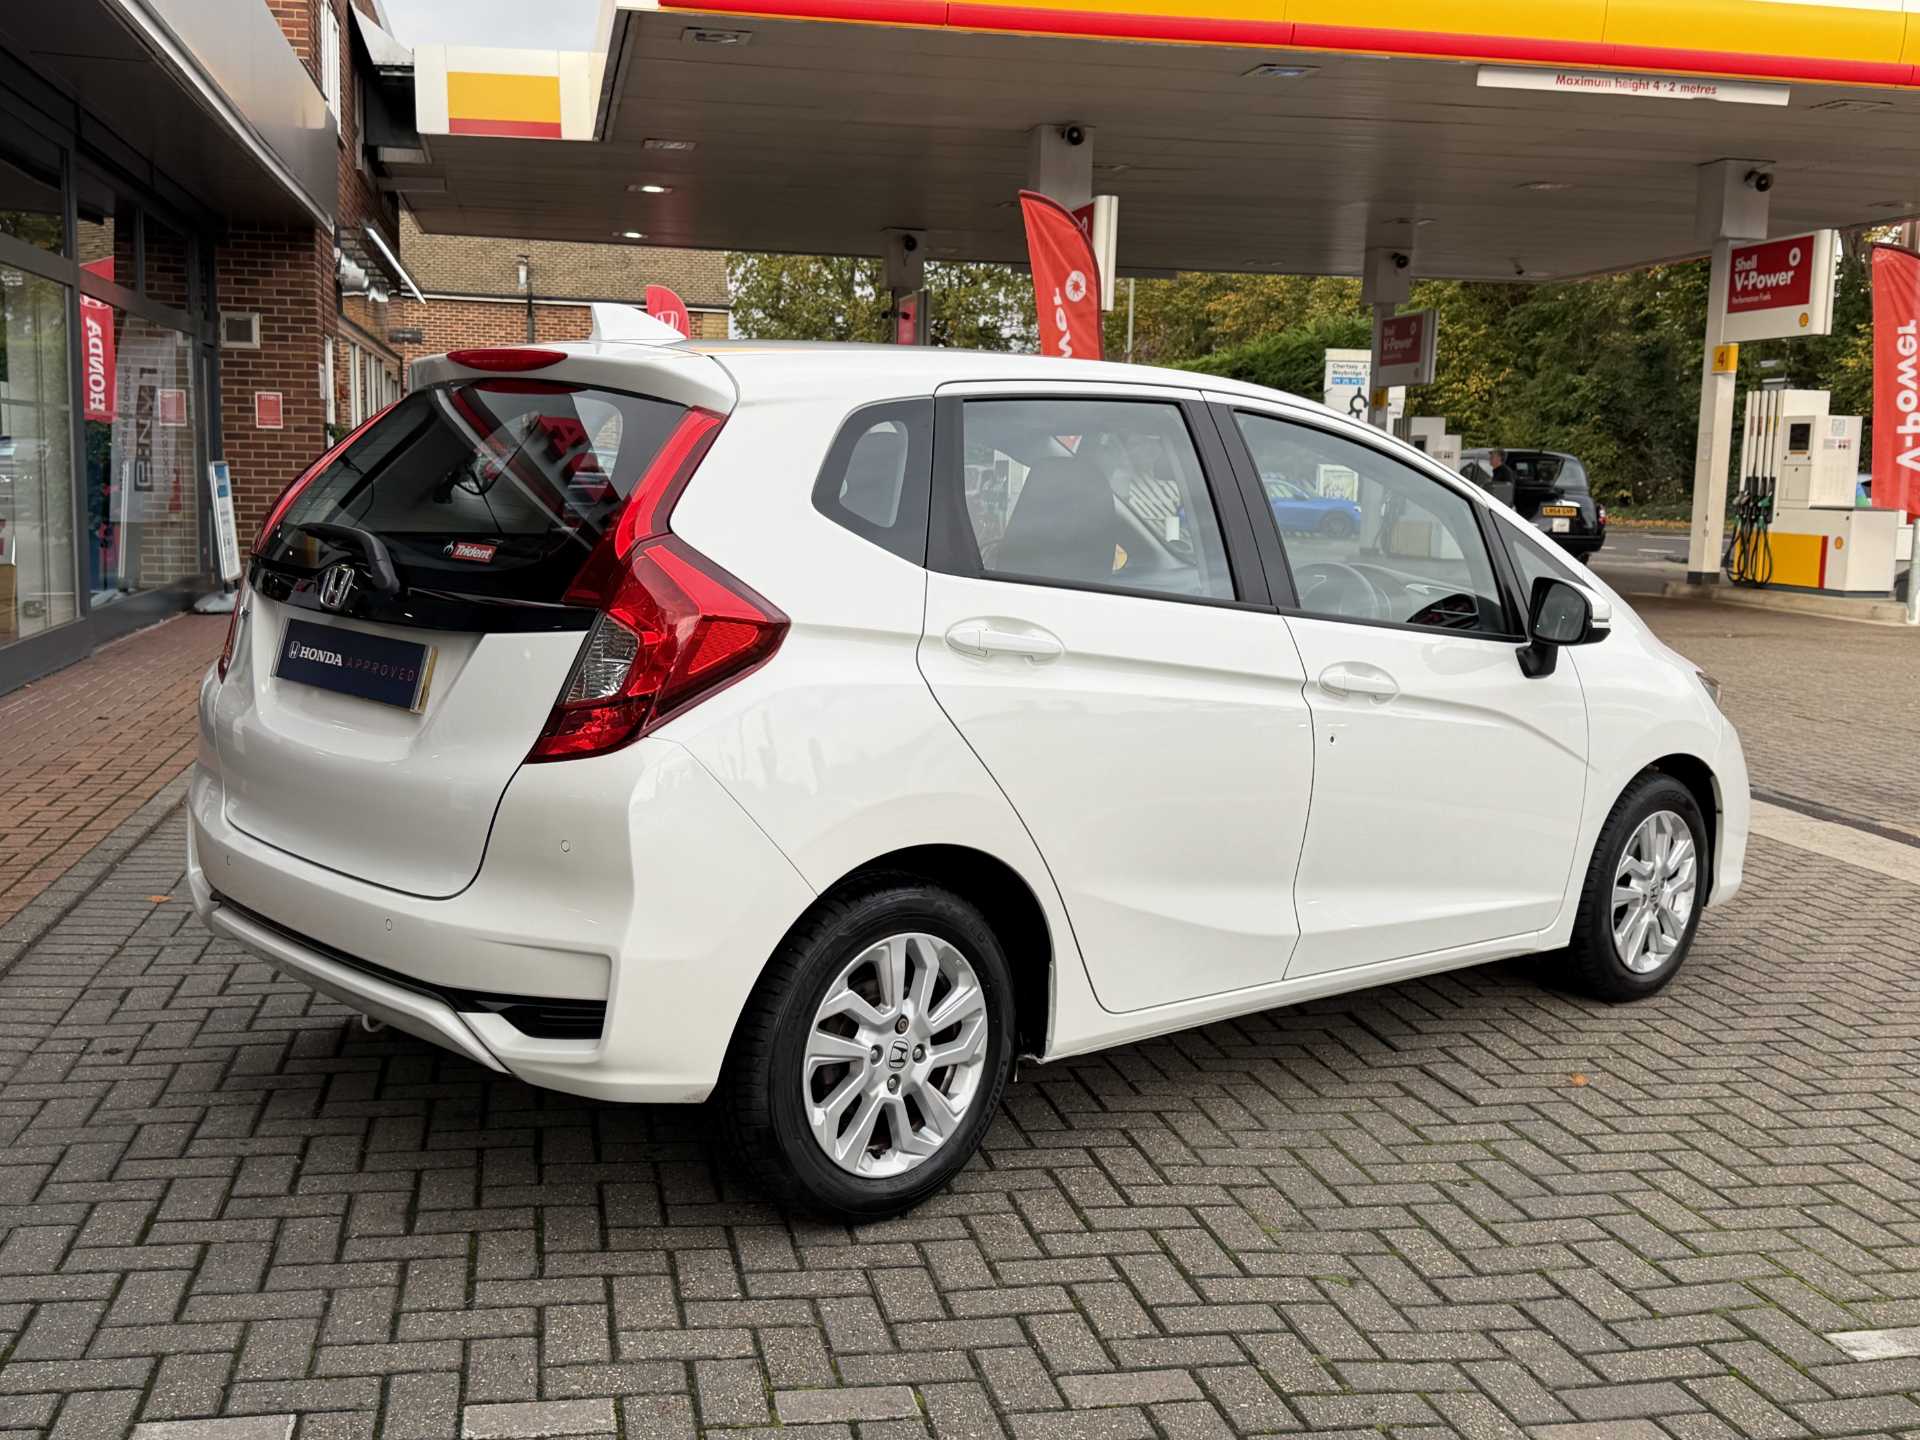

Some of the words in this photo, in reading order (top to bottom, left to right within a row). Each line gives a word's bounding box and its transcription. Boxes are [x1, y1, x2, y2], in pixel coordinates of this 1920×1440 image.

[1555, 74, 1611, 88] Maximum
[1615, 77, 1650, 92] height
[1680, 82, 1717, 95] metres
[1735, 254, 1758, 272] Shell
[1734, 270, 1795, 292] V-Power
[1718, 351, 1725, 367] 4
[456, 545, 493, 559] Trident
[299, 646, 343, 666] HONDA
[345, 656, 415, 682] APPROVED
